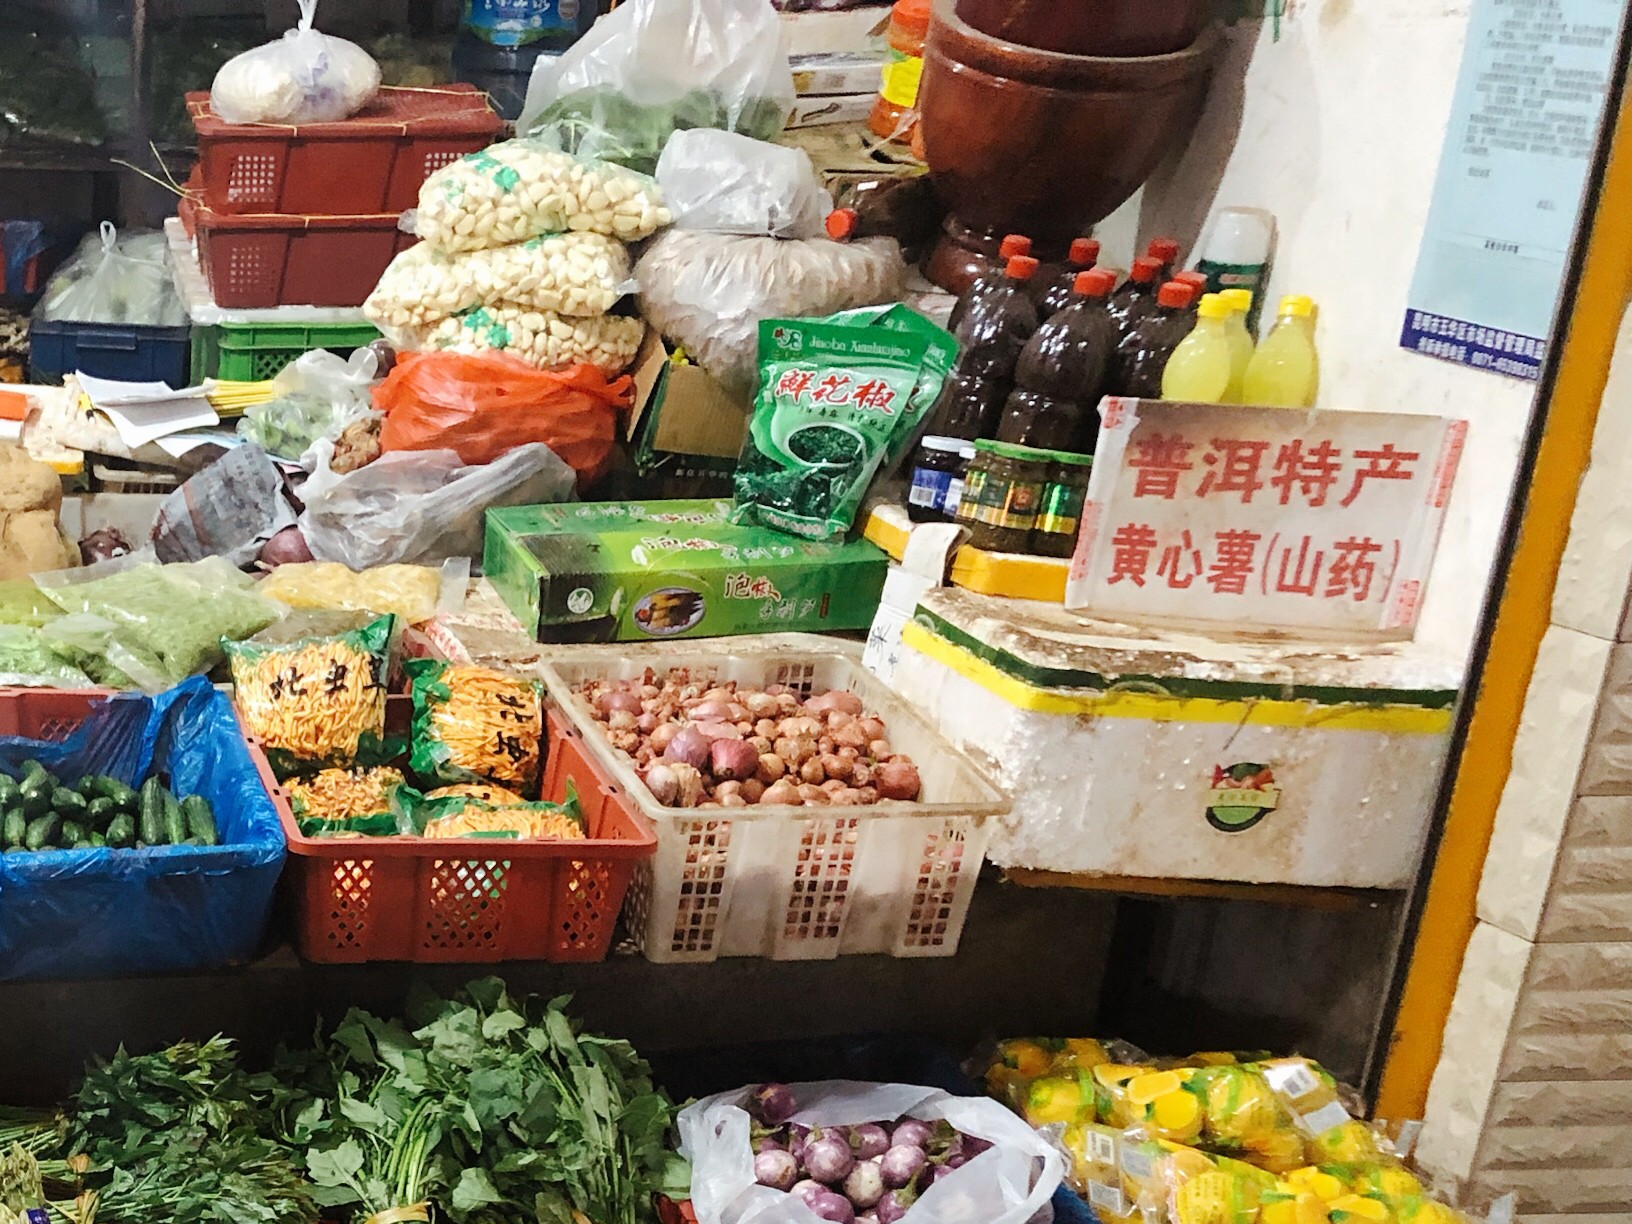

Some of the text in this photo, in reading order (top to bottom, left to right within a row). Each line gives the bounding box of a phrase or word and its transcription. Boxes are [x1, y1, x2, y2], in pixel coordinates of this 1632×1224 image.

[1127, 432, 1420, 508] 普洱特产
[1106, 522, 1401, 604] 黄心薯(山药)
